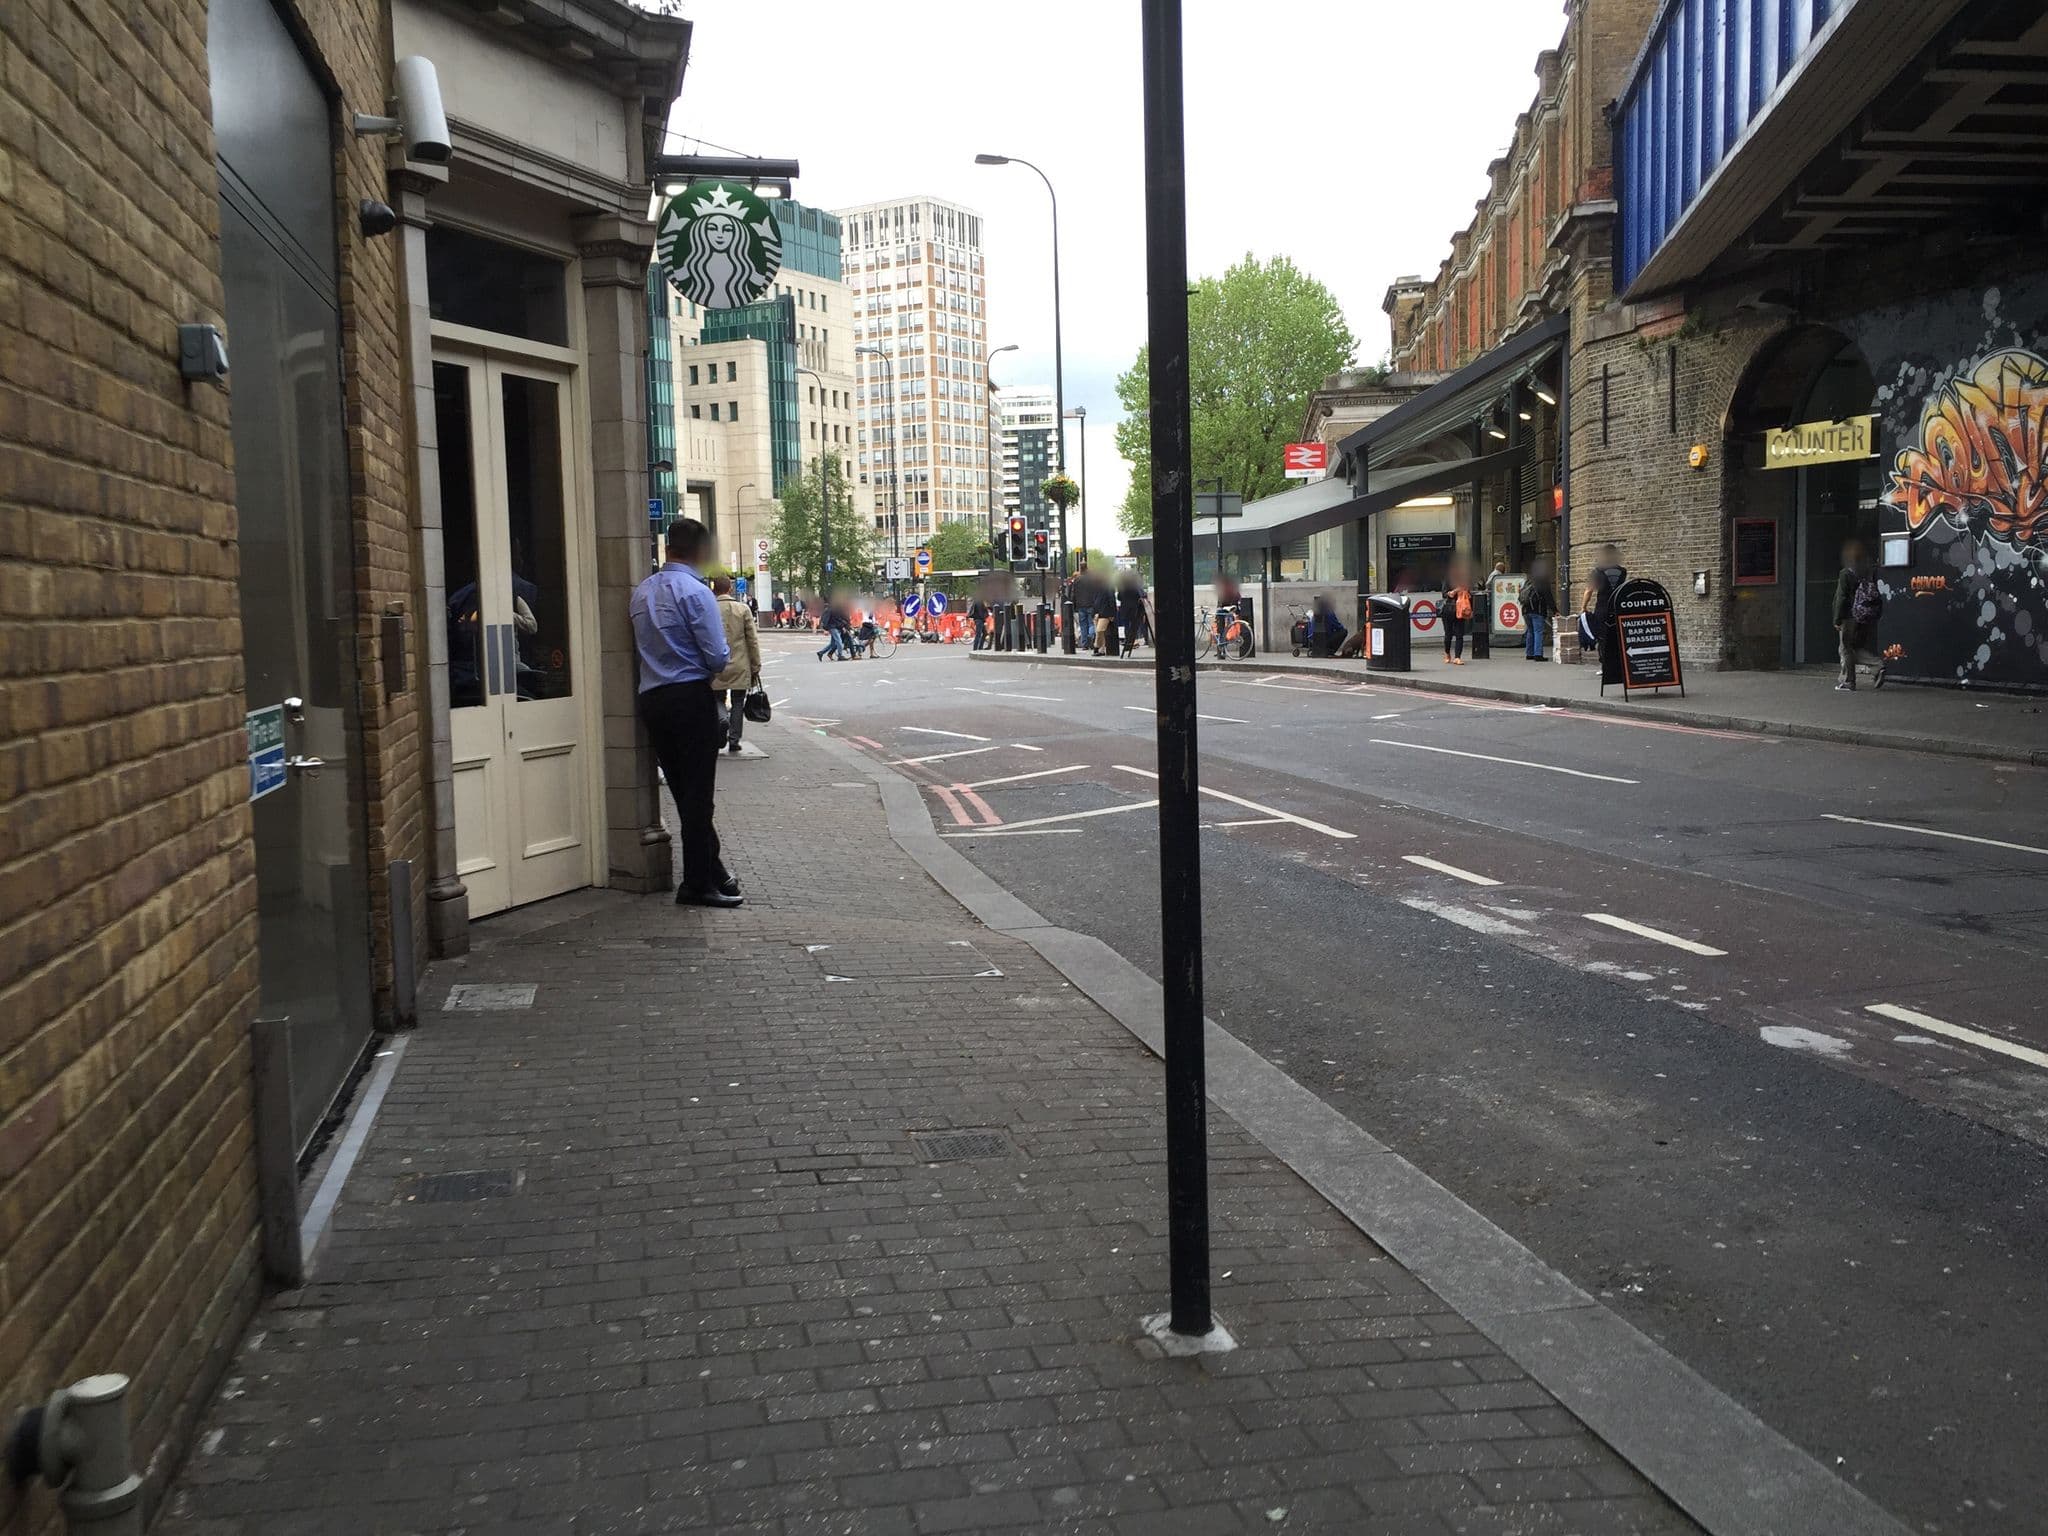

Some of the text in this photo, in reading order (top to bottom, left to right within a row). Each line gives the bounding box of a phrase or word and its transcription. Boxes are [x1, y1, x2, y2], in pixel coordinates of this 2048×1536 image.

[1771, 425, 1865, 460] COUNTER
[1620, 599, 1665, 609] COUNTER
[1503, 609, 1516, 620] £3
[1622, 618, 1666, 627] VAUXHALL'S
[1645, 626, 1662, 634] AND
[1626, 635, 1666, 643] BRASSERIE
